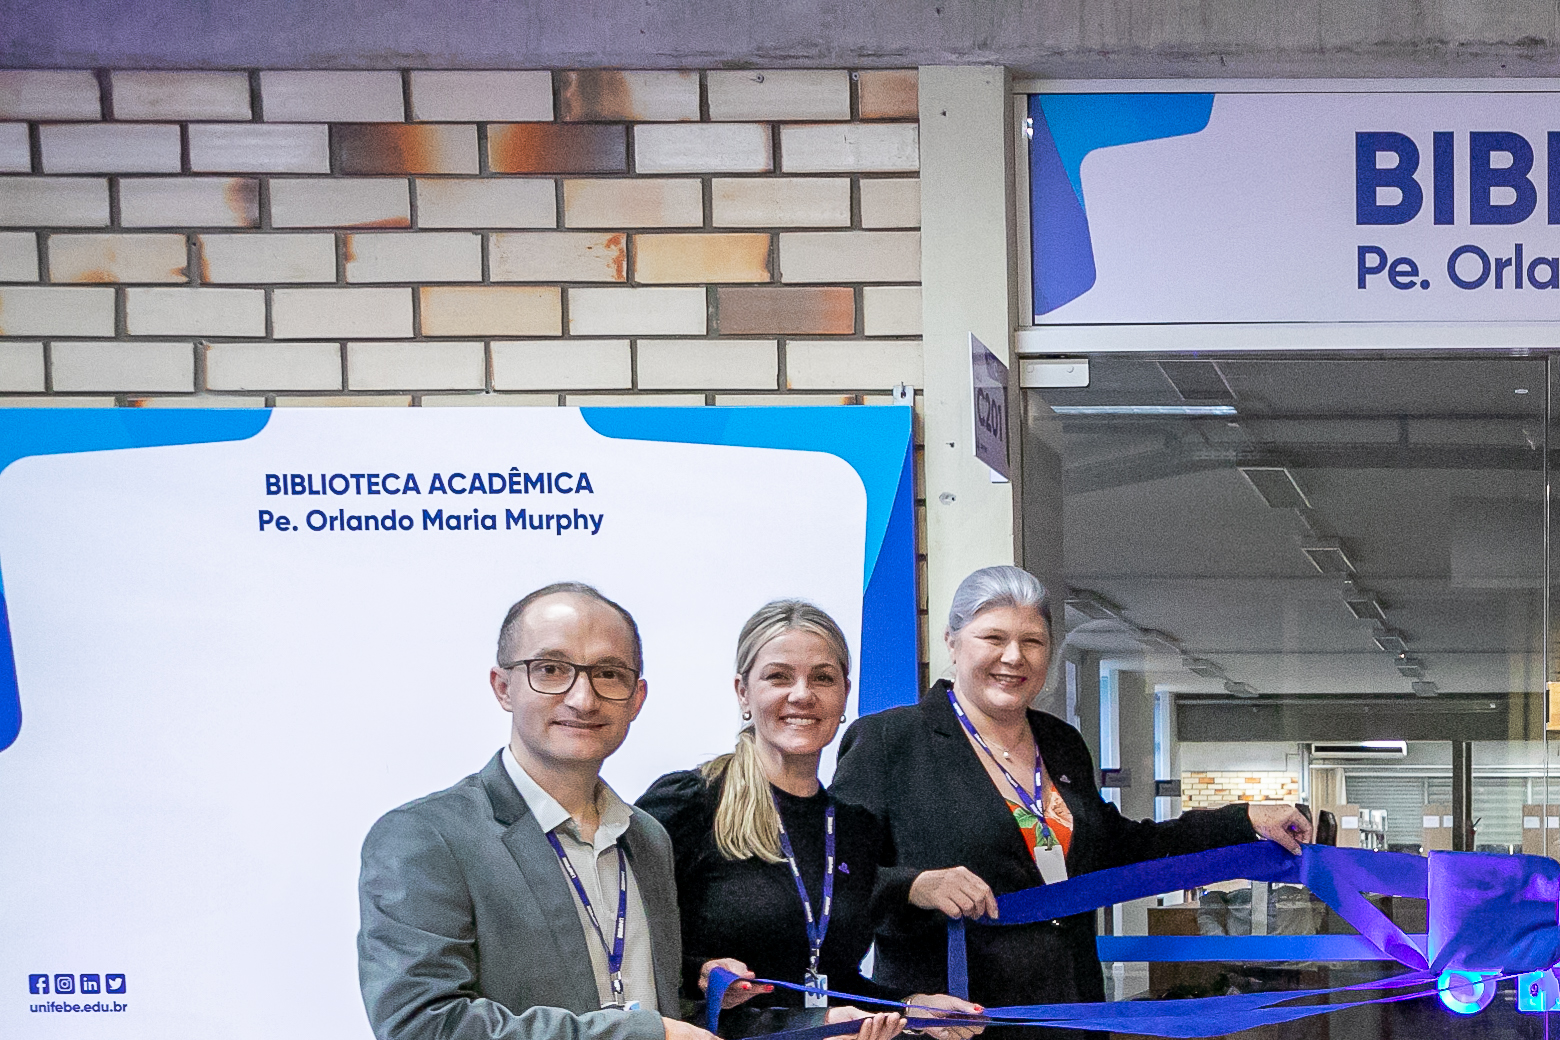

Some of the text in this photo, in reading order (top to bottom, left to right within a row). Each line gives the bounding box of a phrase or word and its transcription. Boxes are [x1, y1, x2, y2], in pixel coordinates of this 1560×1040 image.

[1357, 245, 1430, 291] Pe.
[266, 466, 594, 496] BIBLIOTECA ACADÊMICA
[258, 508, 604, 537] Pe. Orlando Maria Murphy
[30, 1001, 128, 1013] unifebe.edu.br
